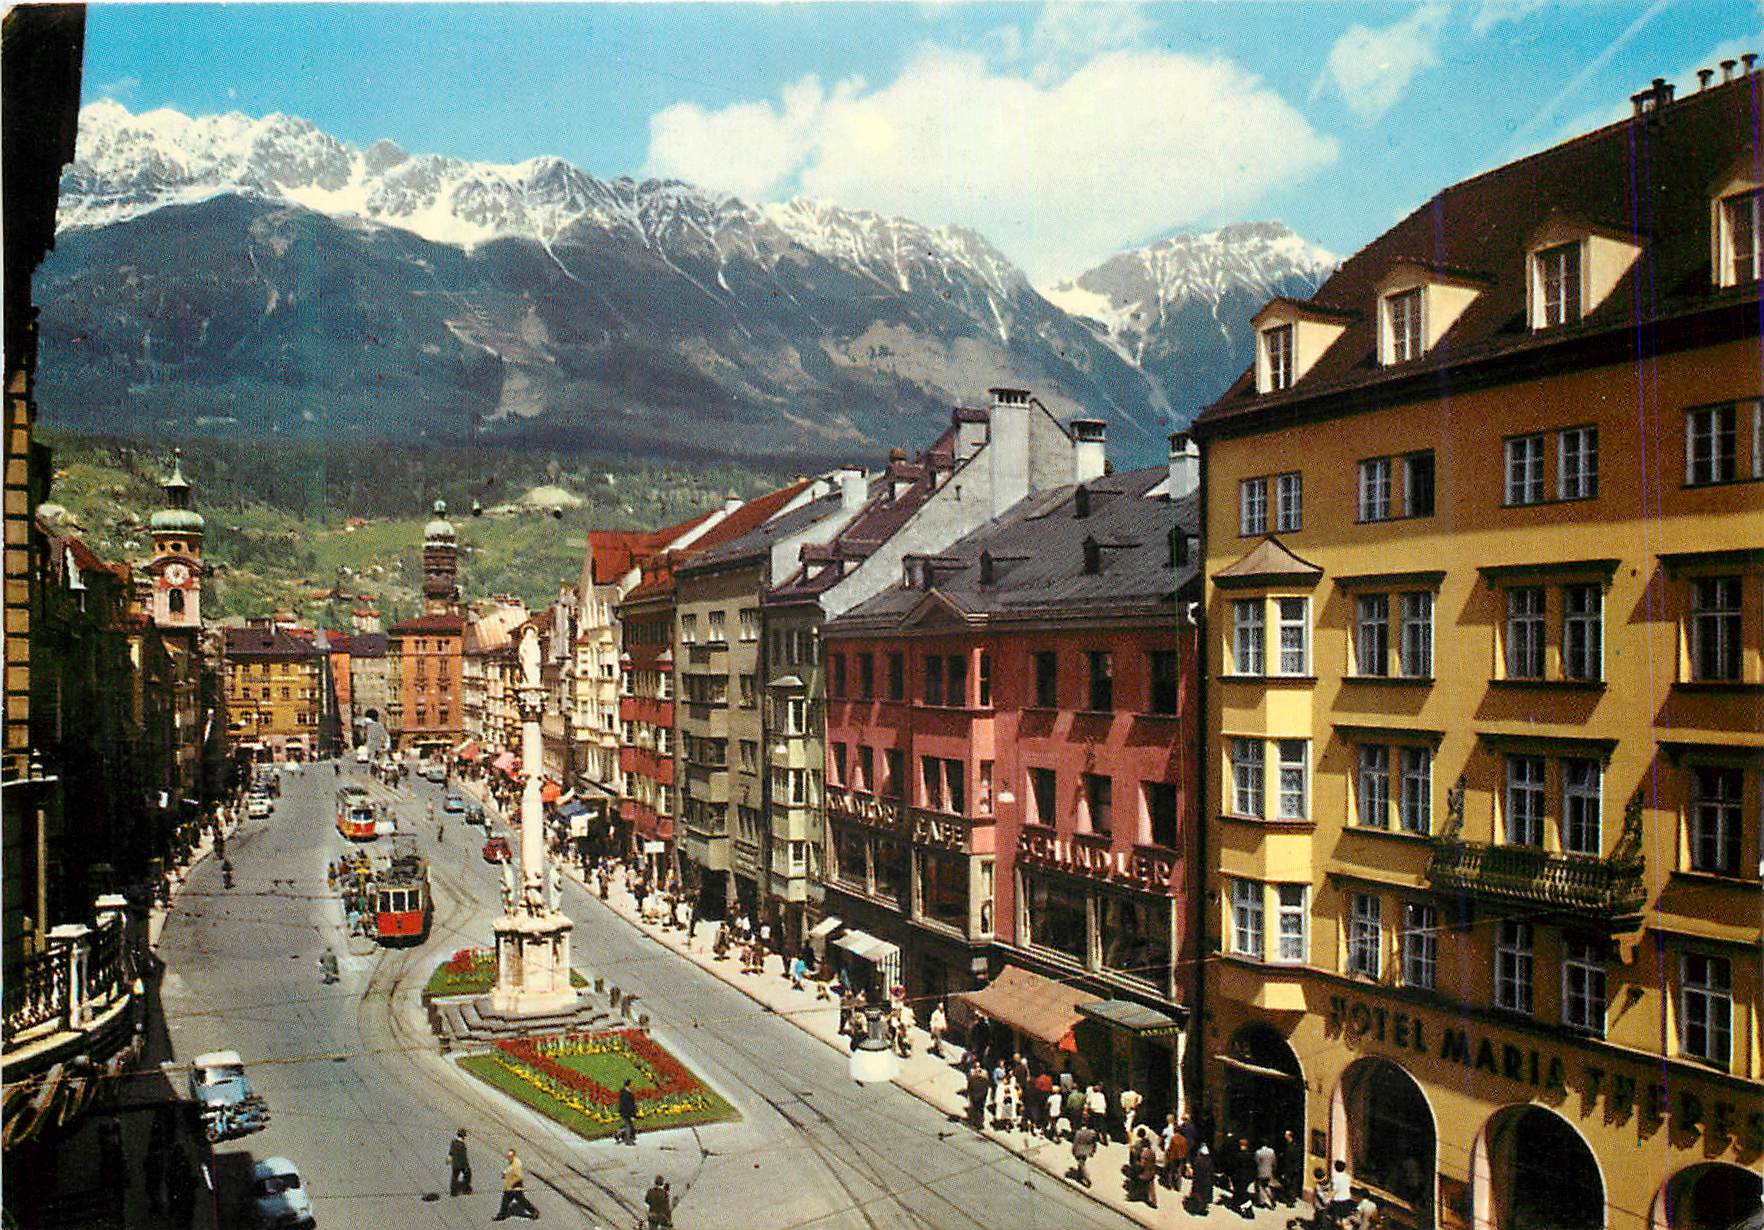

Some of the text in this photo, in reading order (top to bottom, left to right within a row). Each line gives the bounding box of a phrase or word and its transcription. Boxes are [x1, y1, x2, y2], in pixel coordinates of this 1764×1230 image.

[1017, 832, 1172, 890] SCHINDLER
[1330, 995, 1429, 1054] HOTEL
[1440, 1027, 1567, 1091] MARIA
